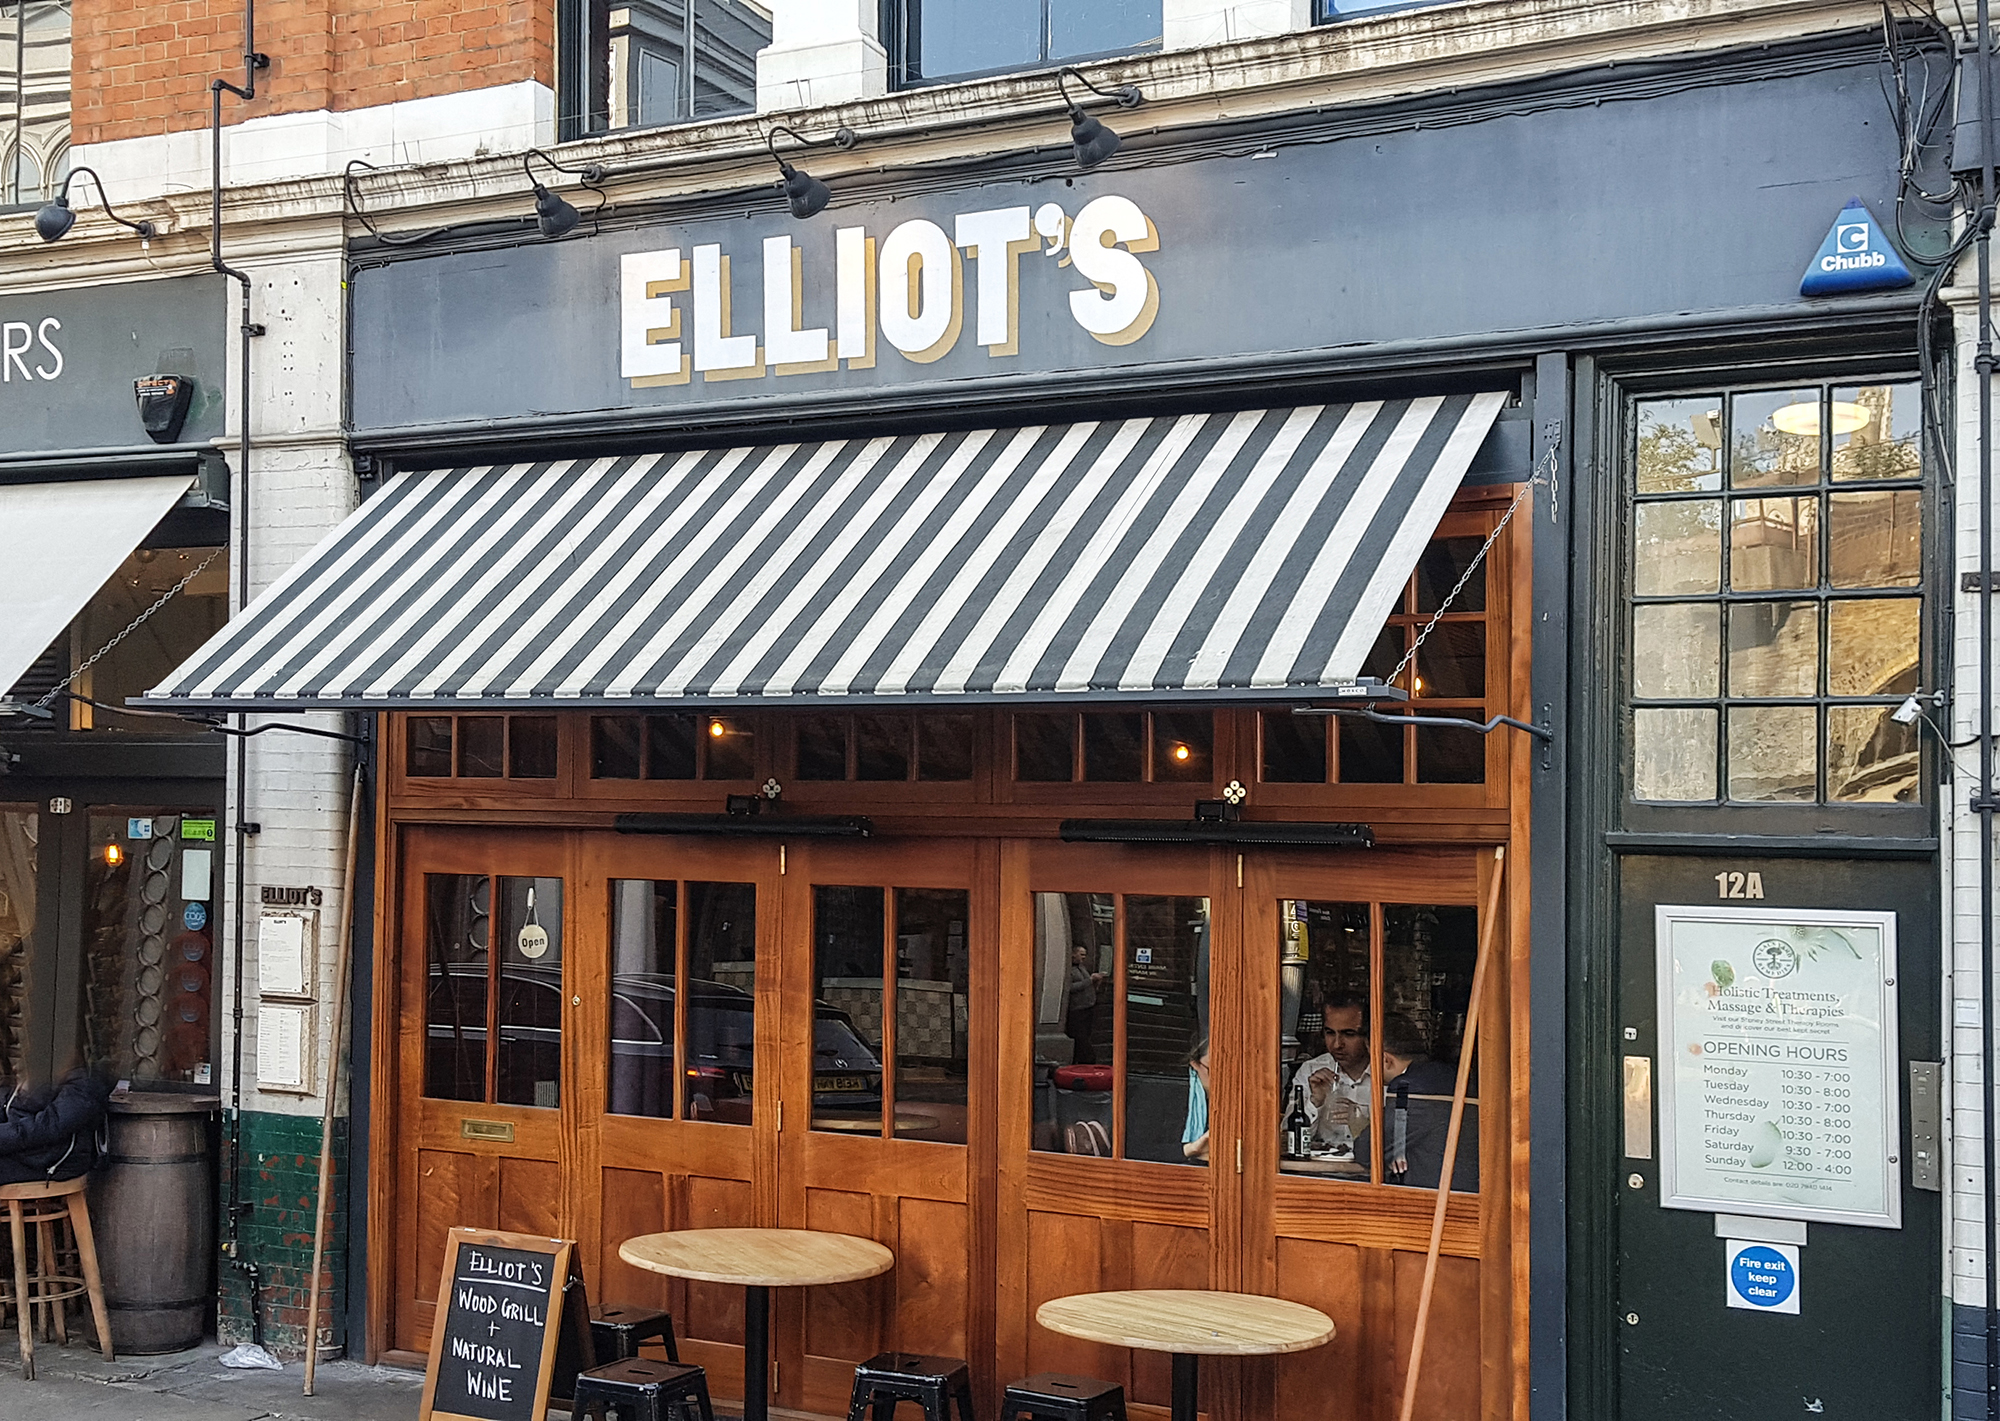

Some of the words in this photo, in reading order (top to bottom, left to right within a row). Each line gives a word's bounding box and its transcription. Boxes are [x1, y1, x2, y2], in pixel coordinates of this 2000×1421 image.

[1821, 251, 1885, 272] Chubb
[620, 195, 1160, 389] ELLIOT'S
[3, 317, 63, 382] RS
[1714, 871, 1765, 899] 12A
[261, 886, 323, 906] ELLIOT'S
[522, 938, 545, 949] Open
[1712, 985, 1760, 998] Holistic
[1762, 987, 1840, 1004] Treatments,
[1707, 999, 1762, 1015] Massage
[1765, 1002, 1776, 1014] &
[1781, 1003, 1845, 1018] Therapies
[1703, 1041, 1781, 1058] OPENING
[1787, 1046, 1848, 1062] HOURS
[1703, 1064, 1748, 1078] Monday
[1781, 1069, 1812, 1080] 10:30
[1823, 1072, 1851, 1083] 7:00
[1704, 1079, 1750, 1093] Tuesday
[1781, 1085, 1812, 1096] 10:30
[1823, 1088, 1851, 1098] 8:00
[1704, 1095, 1769, 1109] Wednesday
[1781, 1100, 1812, 1111] 10:30
[1824, 1103, 1851, 1113] 7:00
[1704, 1109, 1756, 1123] Thursday
[1781, 1115, 1812, 1126] 10:30
[1823, 1118, 1851, 1129] 8:00
[1704, 1124, 1740, 1137] Friday
[1782, 1130, 1813, 1141] 10:30
[1824, 1133, 1851, 1144] 7:00
[1704, 1140, 1754, 1153] Saturday
[1785, 1146, 1811, 1156] 9:30
[1825, 1149, 1851, 1159] 7:00
[1704, 1154, 1746, 1168] Sunday
[1783, 1161, 1813, 1172] 12:00
[1825, 1164, 1852, 1175] 4:00
[469, 1250, 543, 1286] ELLIOT'S
[1740, 1257, 1761, 1269] Fire
[1764, 1261, 1786, 1271] exit
[1748, 1272, 1777, 1285] keep
[1748, 1286, 1777, 1297] clear
[458, 1287, 498, 1314] WOOD
[501, 1298, 544, 1326] GRILL
[452, 1336, 522, 1369] NATURAL
[467, 1369, 513, 1402] WINE
